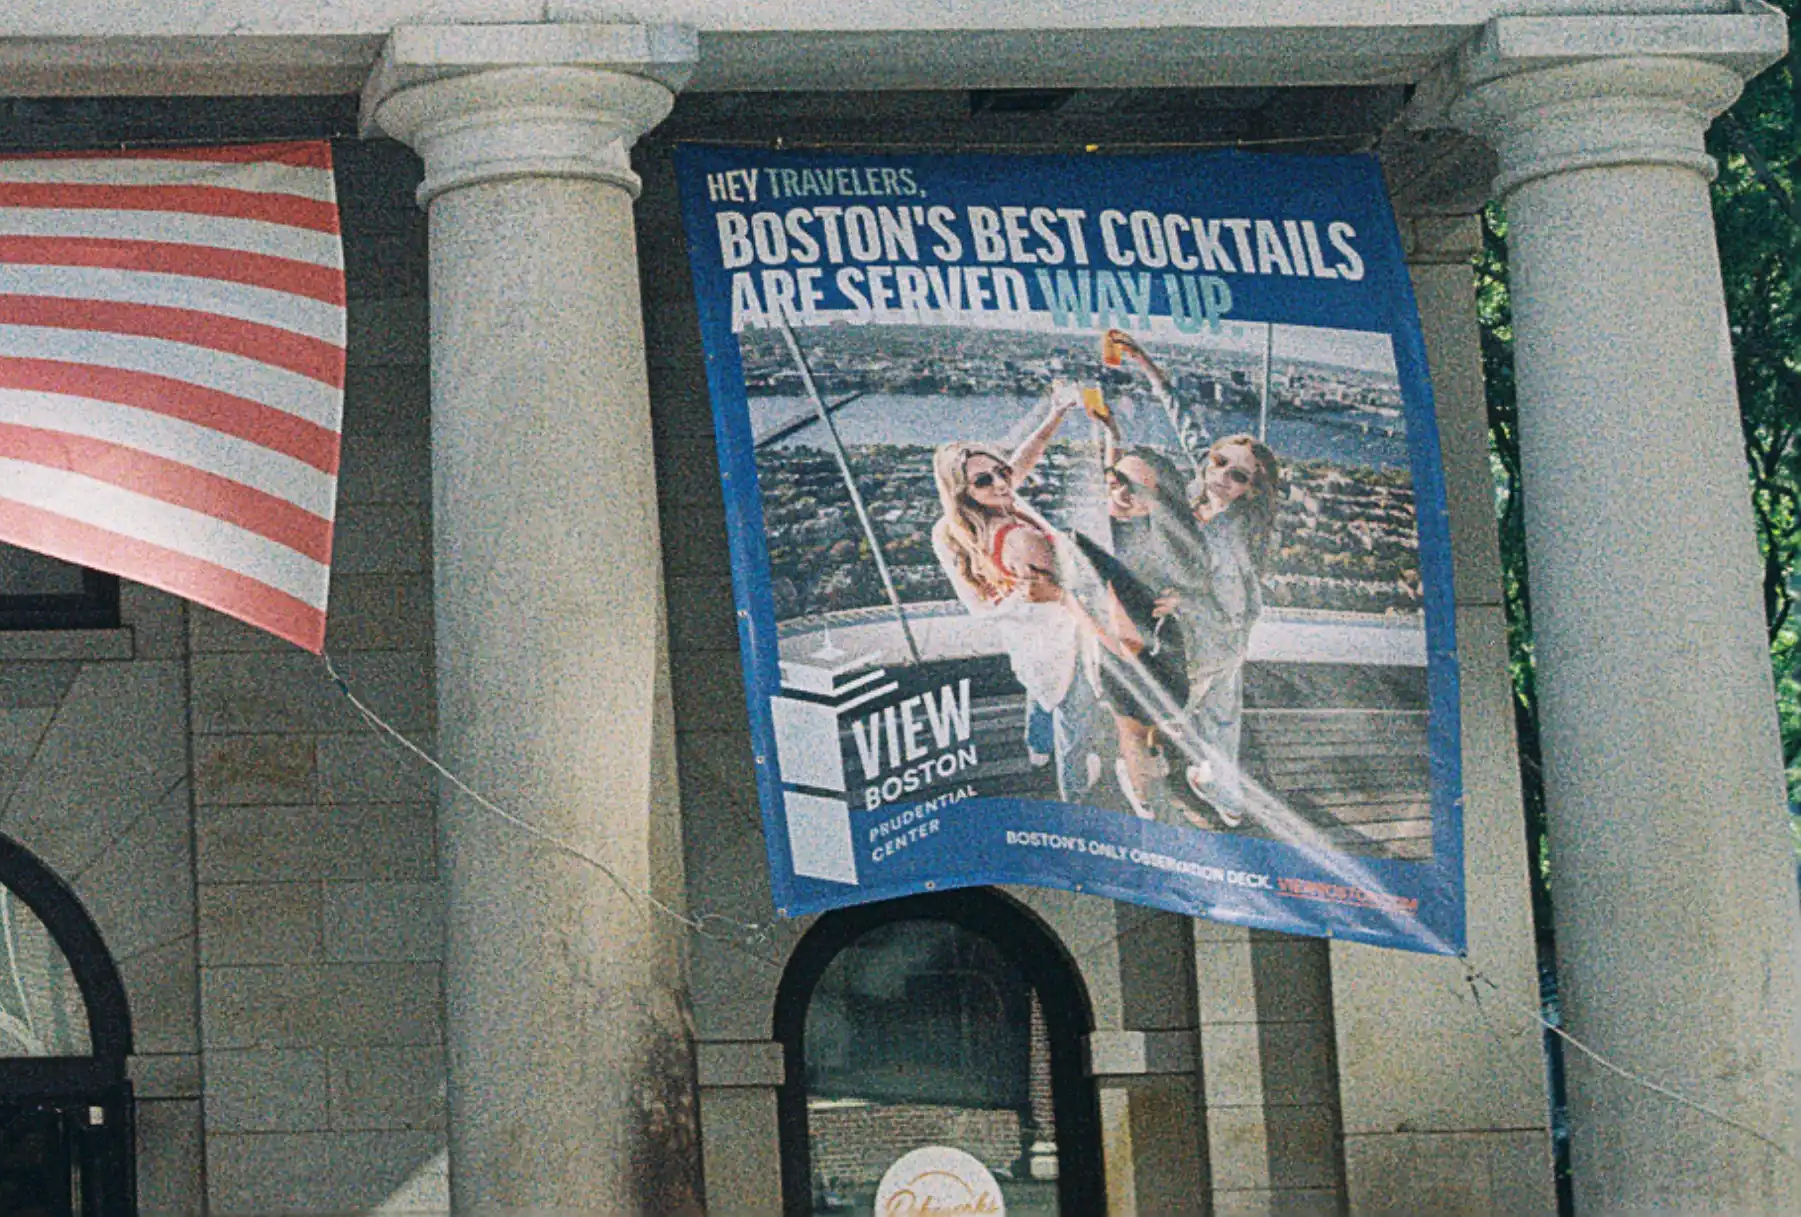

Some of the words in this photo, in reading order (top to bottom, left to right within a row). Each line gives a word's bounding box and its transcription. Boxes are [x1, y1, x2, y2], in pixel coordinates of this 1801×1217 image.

[707, 168, 758, 202] HEY
[763, 167, 927, 198] TRAVELERS,
[715, 205, 962, 269] BOSTON'S
[968, 208, 1088, 266] BEST
[1101, 210, 1366, 281] COCKTAILS
[732, 267, 824, 333] ARE
[836, 265, 1031, 329] SERVED
[1034, 267, 1151, 331] WAY
[852, 678, 972, 781] VIEW
[864, 744, 978, 812] BOSTON
[869, 784, 978, 844] PRUDENTIAL
[871, 819, 941, 862] CENTER
